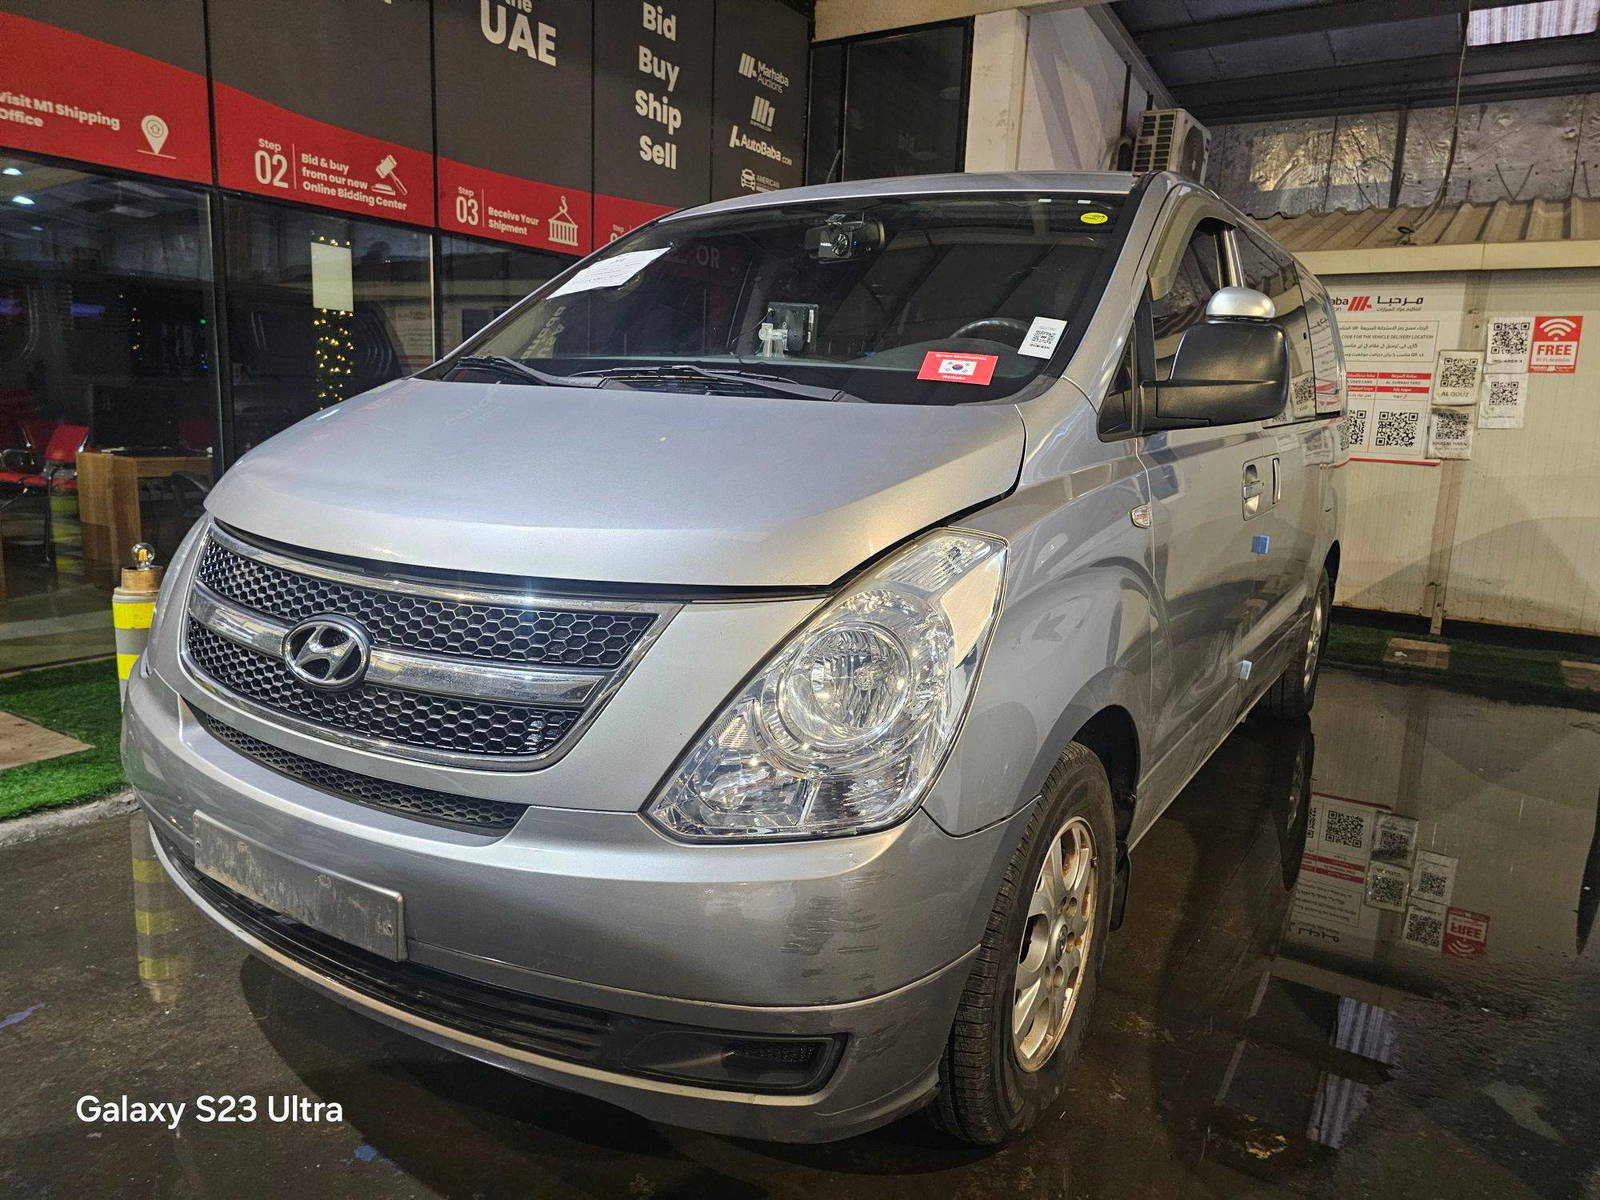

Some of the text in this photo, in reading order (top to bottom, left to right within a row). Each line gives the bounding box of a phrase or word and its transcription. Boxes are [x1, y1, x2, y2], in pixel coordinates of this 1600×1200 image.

[480, 0, 556, 67] UAE
[643, 1, 677, 42] Bid
[638, 45, 680, 92] Buy
[757, 60, 789, 88] Marhaba
[0, 91, 32, 109] Visit
[635, 89, 682, 135] Ship
[0, 108, 43, 127] Office
[55, 103, 120, 131] Shipping
[258, 138, 282, 153] Step
[639, 135, 677, 170] Sell
[254, 150, 289, 189] 02
[301, 153, 349, 175] Bid & buy
[301, 167, 369, 190] from our new
[458, 186, 475, 198] Step
[302, 181, 408, 211] Online Bidding Center
[456, 196, 479, 226] 03
[488, 206, 540, 227] Receive Your
[488, 219, 528, 236] Shipment
[1537, 344, 1573, 356] FREE
